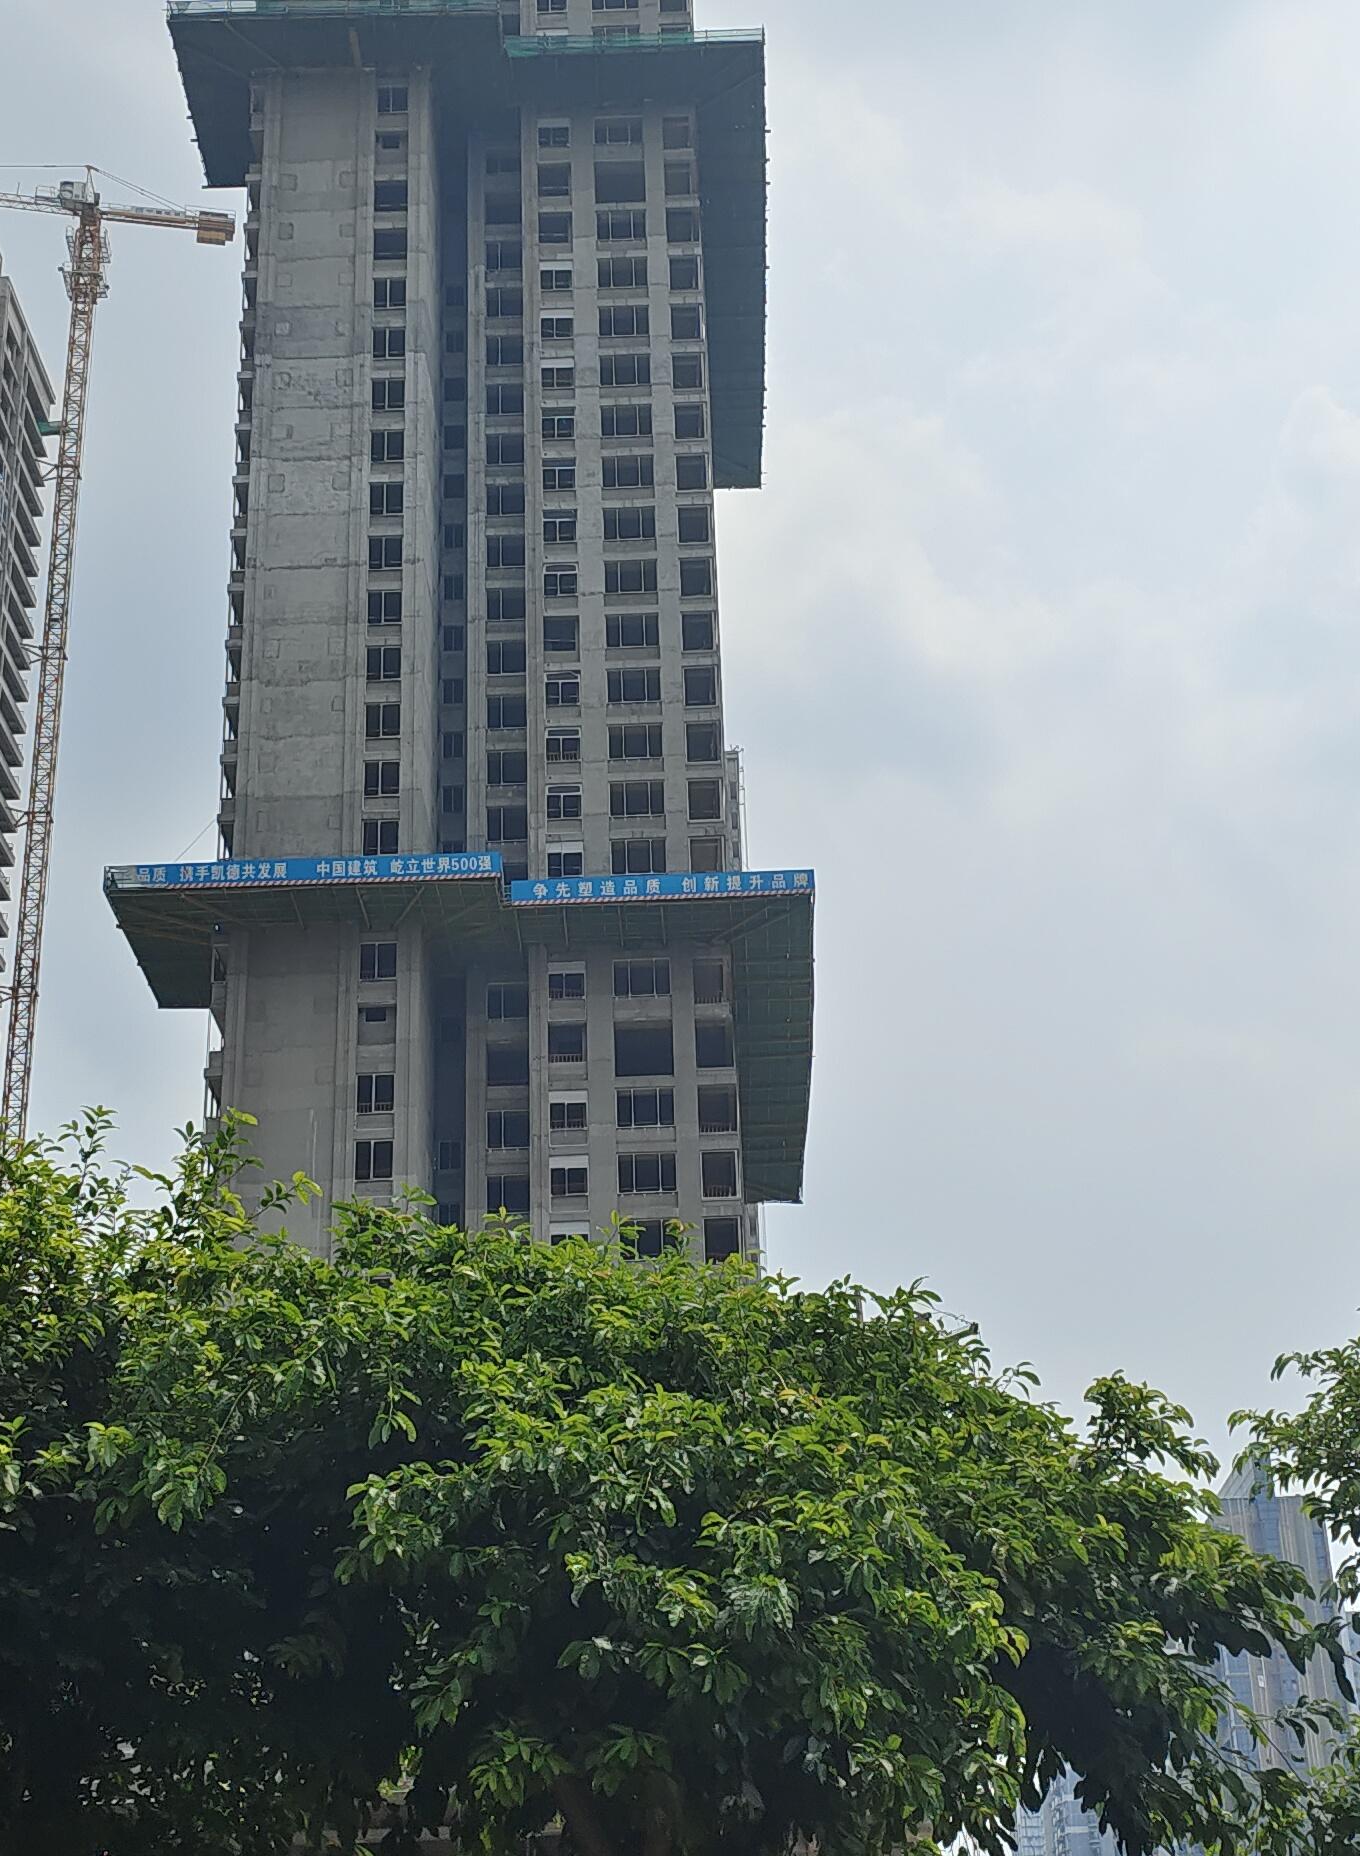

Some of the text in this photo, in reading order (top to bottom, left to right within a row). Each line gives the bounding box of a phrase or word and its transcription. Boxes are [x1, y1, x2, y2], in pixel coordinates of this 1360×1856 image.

[316, 859, 378, 877] 中国建筑
[390, 855, 492, 875] 屹立世界500强
[533, 872, 809, 899] 争先塑造品质 创新提升品牌
